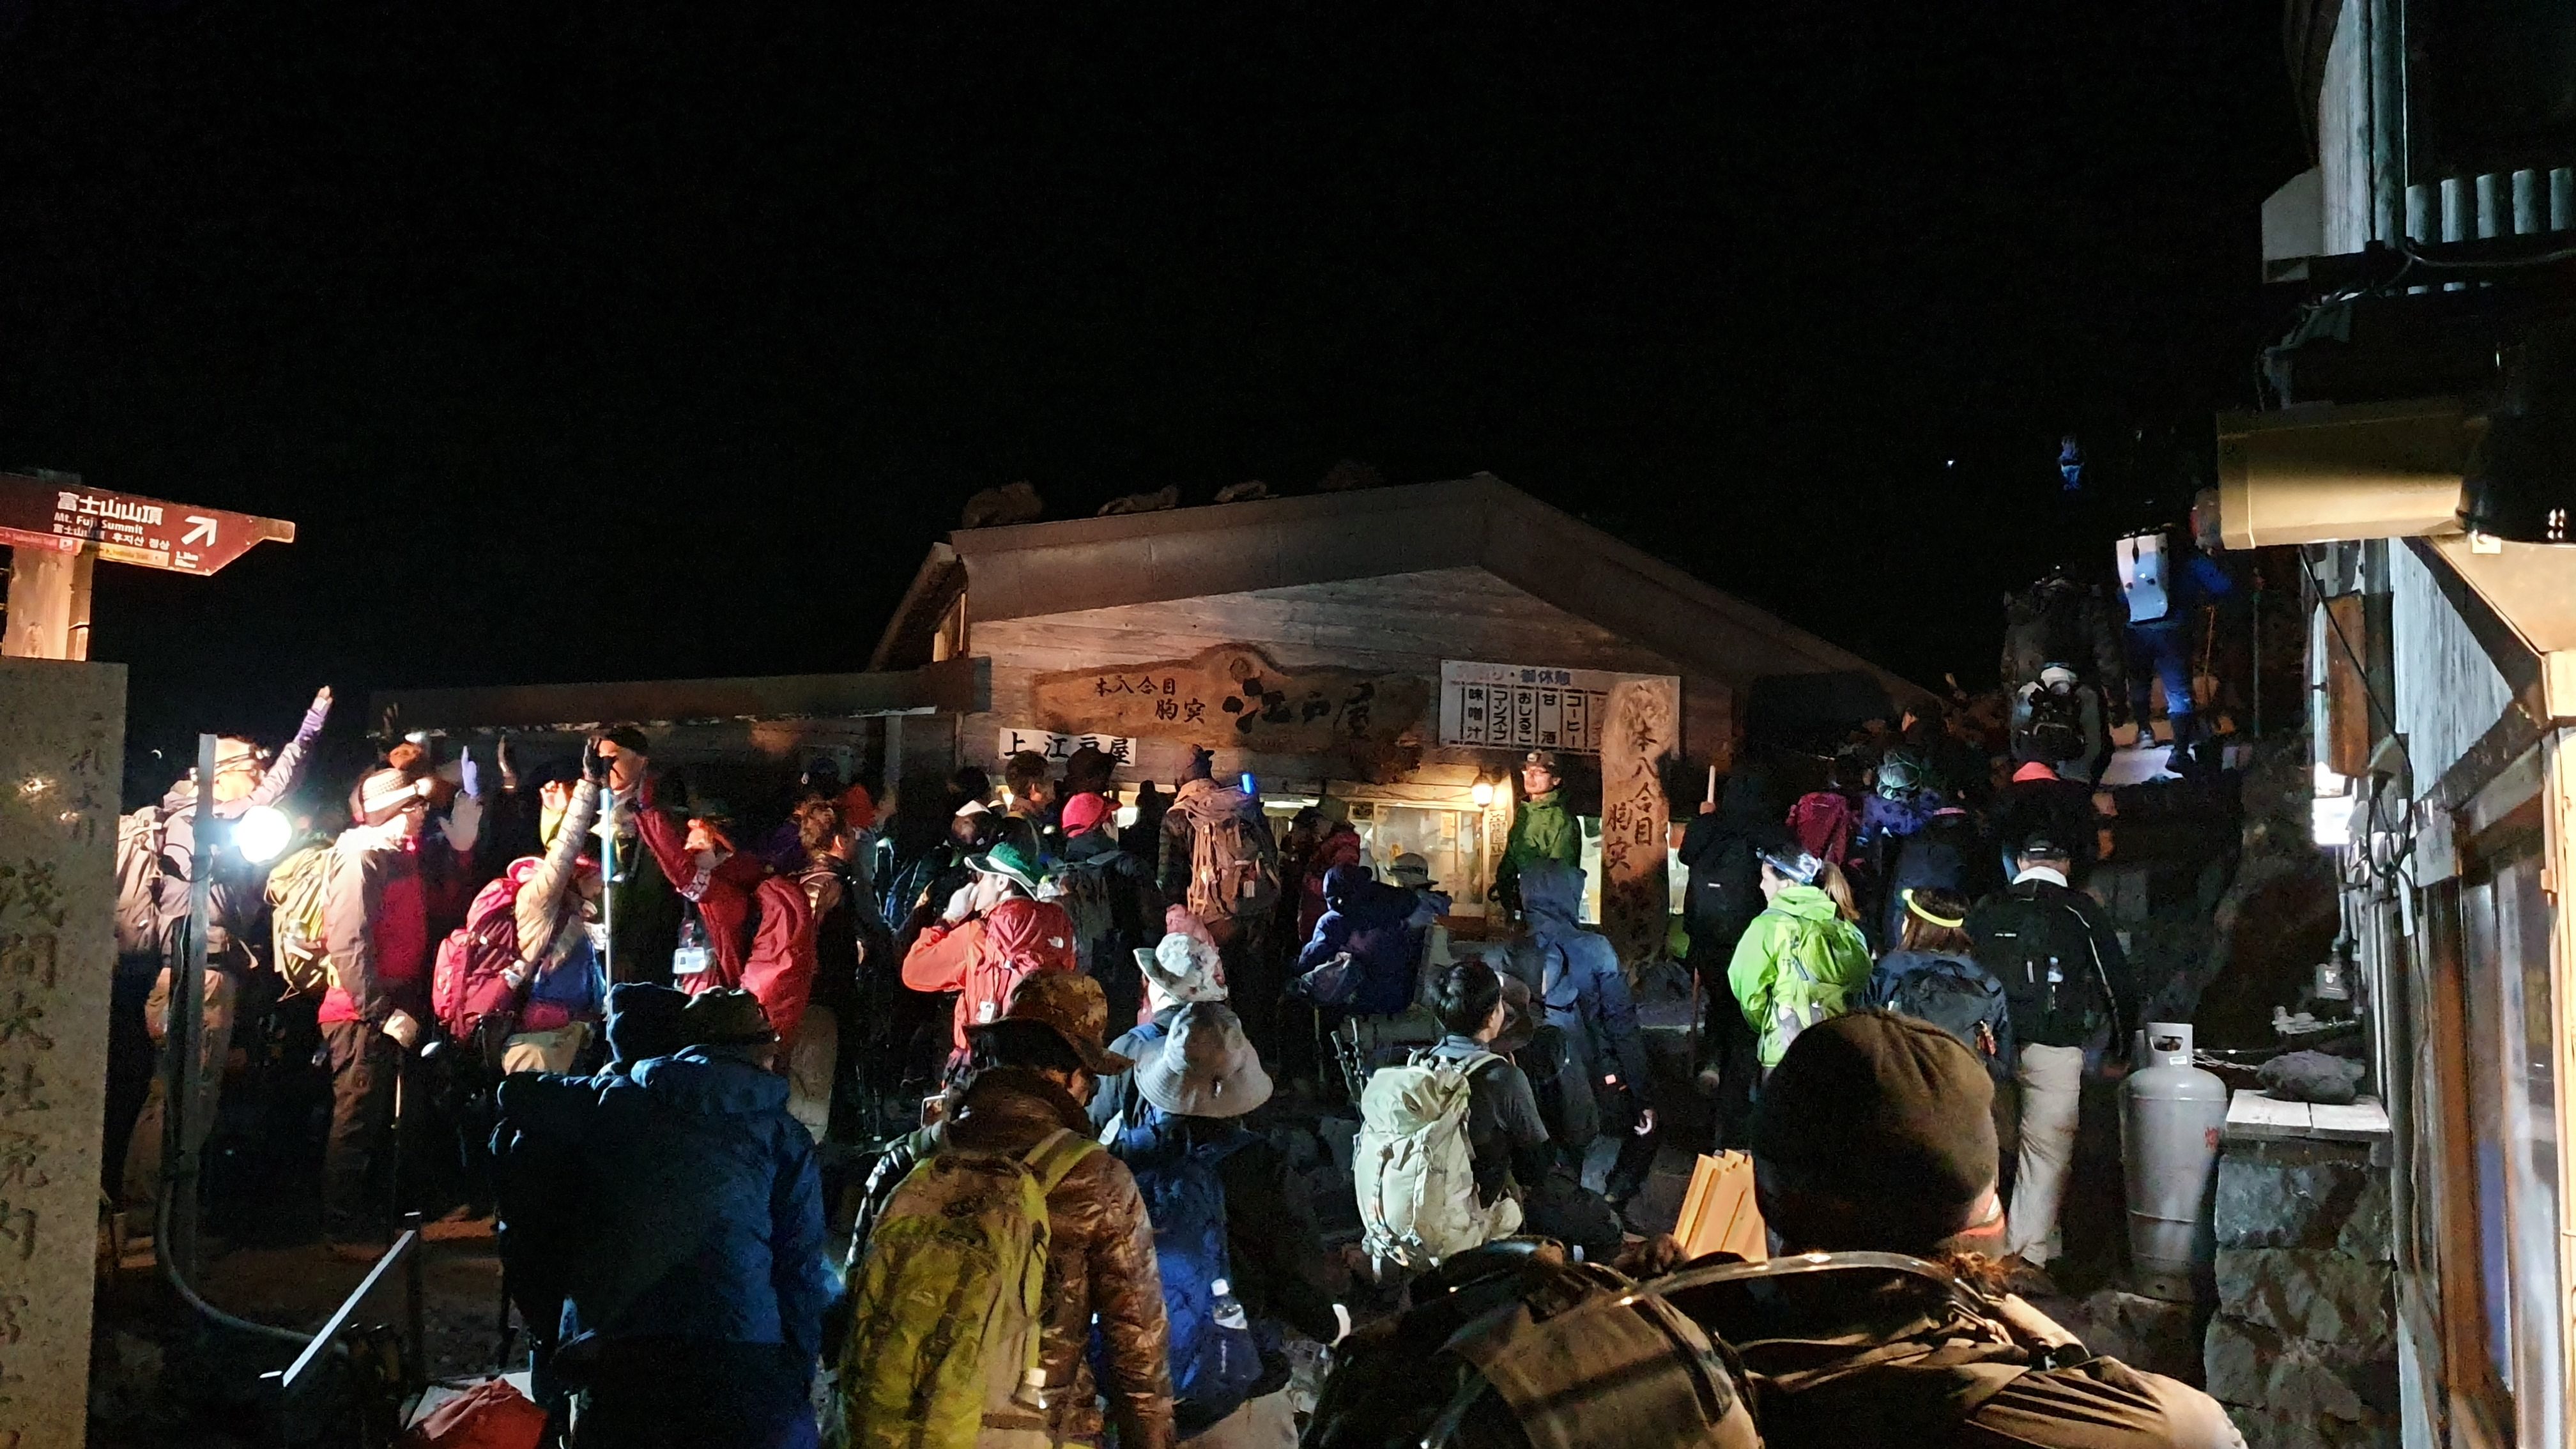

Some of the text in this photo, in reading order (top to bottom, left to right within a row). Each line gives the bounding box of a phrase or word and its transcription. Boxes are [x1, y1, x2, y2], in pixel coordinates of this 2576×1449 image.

[54, 512, 144, 535] Mt. Fuji Summit
[57, 491, 164, 525] 富士山山頂
[112, 532, 145, 547] 후지산
[1095, 675, 1176, 697] 本八合目
[1468, 688, 1483, 739] 味噌汁
[1518, 692, 1532, 742] おしるこ
[1567, 695, 1582, 746] コーヒー
[1629, 720, 1659, 847] 本八合目
